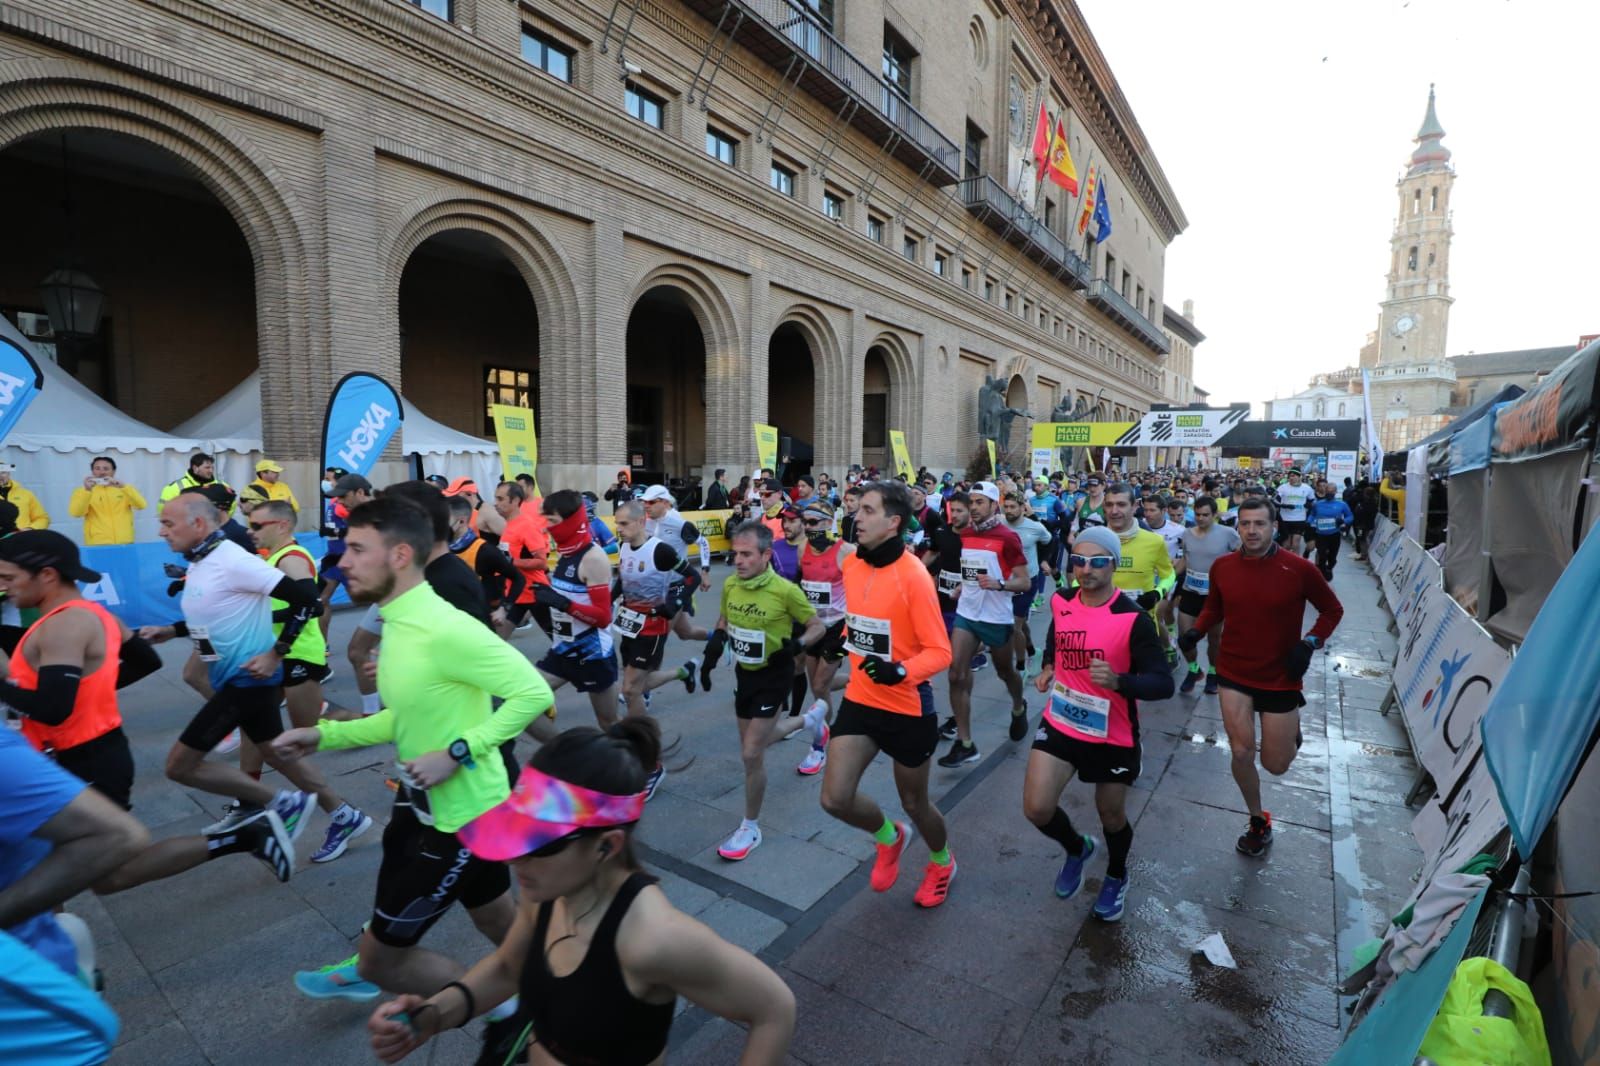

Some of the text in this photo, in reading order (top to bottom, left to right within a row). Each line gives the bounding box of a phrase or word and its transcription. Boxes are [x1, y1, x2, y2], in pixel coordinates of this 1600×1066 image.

[338, 402, 392, 470] HOKA
[1057, 434, 1089, 442] FILTER
[1290, 428, 1337, 438] CaixaBank
[853, 630, 874, 646] 286
[1064, 703, 1089, 720] 429
